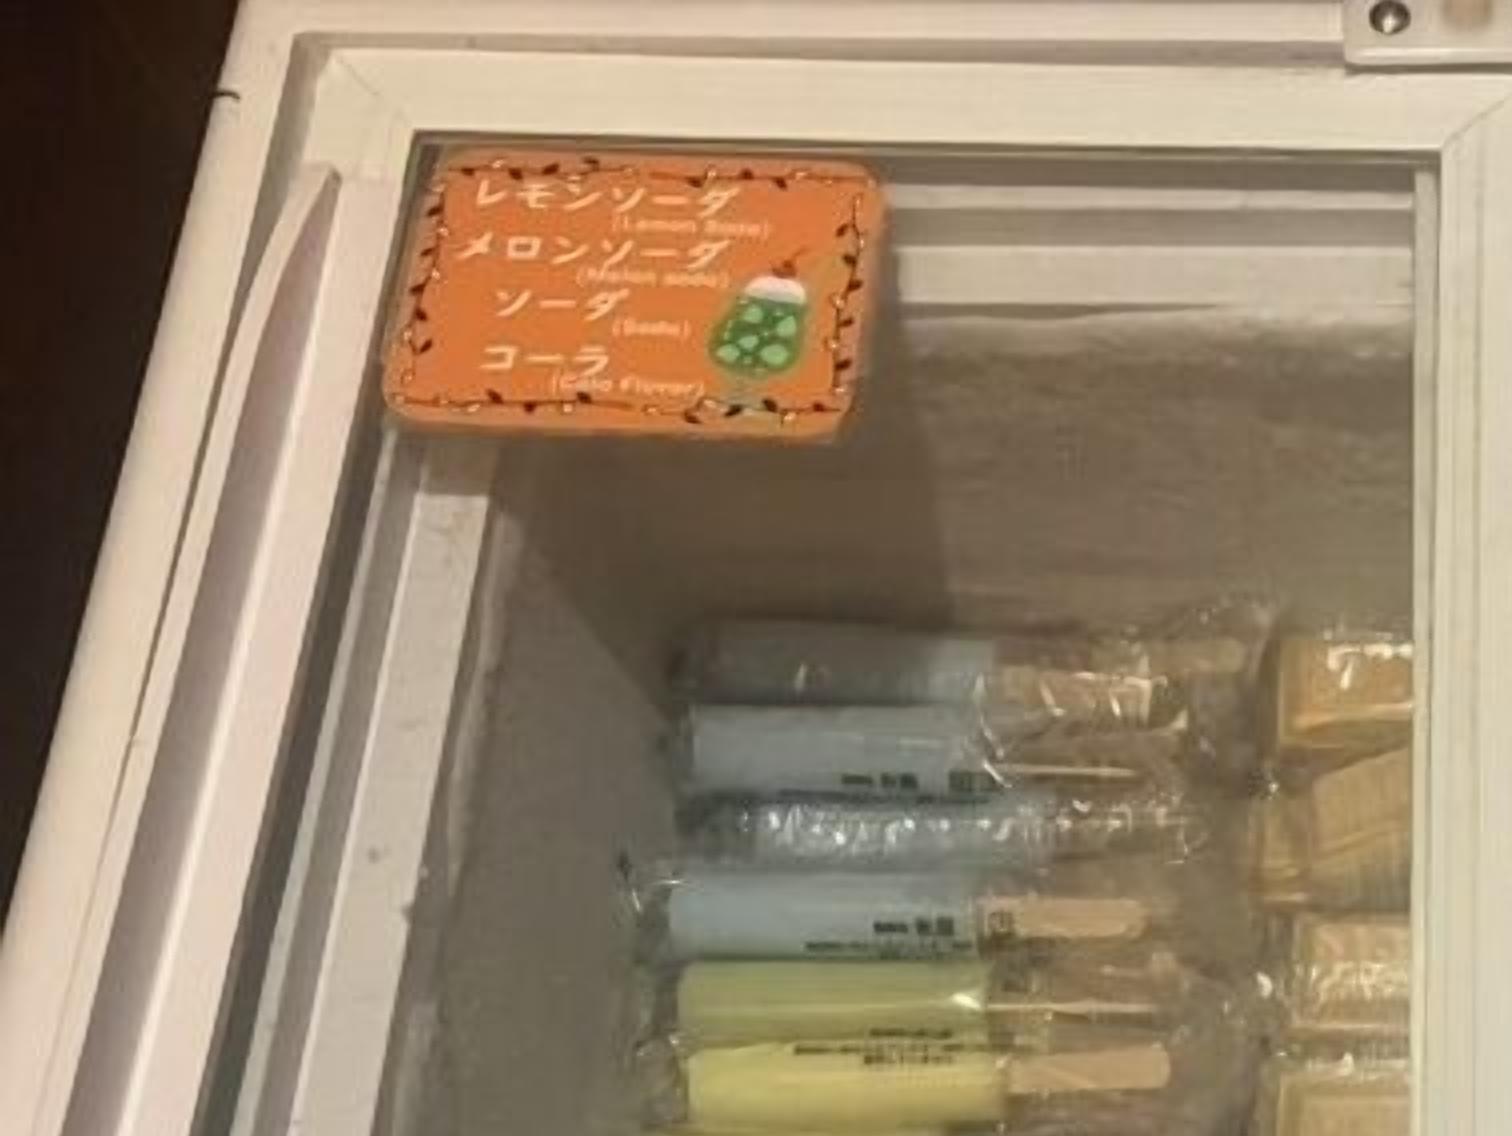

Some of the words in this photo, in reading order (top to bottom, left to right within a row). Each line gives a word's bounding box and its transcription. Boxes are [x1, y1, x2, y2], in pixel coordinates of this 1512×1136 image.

[476, 178, 742, 217] レモンソーダ
[457, 232, 730, 268] メロンソーダ
[496, 288, 629, 320] ソーダ
[479, 345, 609, 376] コーラ
